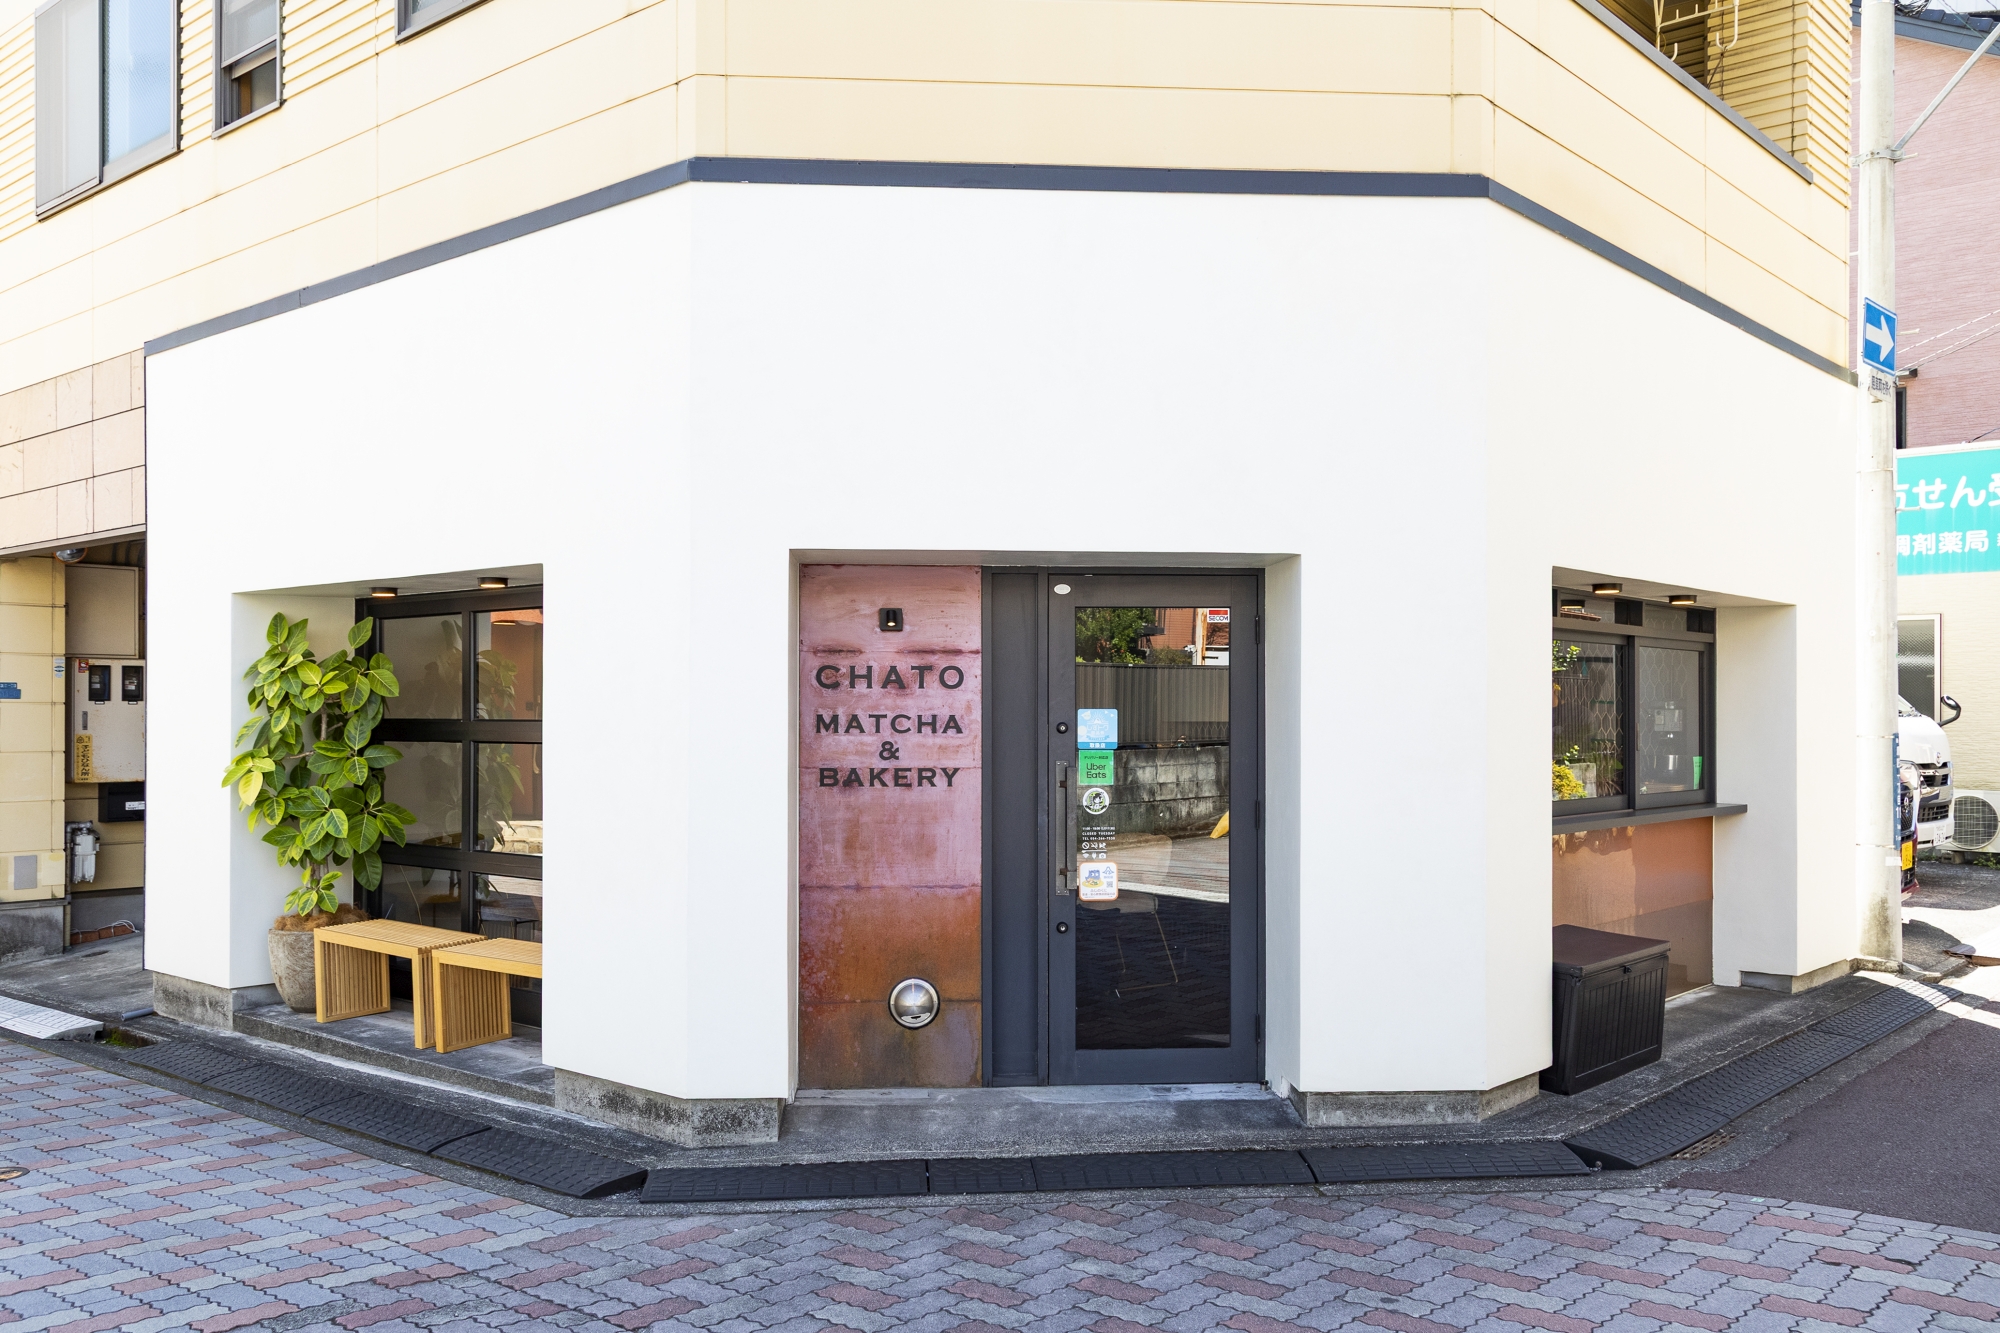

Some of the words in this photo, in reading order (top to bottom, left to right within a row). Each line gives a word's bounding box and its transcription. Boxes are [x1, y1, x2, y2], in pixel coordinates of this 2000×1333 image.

[815, 665, 965, 690] CHATO
[815, 713, 964, 734] MATCHA
[878, 740, 901, 761] &
[818, 767, 961, 788] BAKERY
[1086, 763, 1106, 771] Uber
